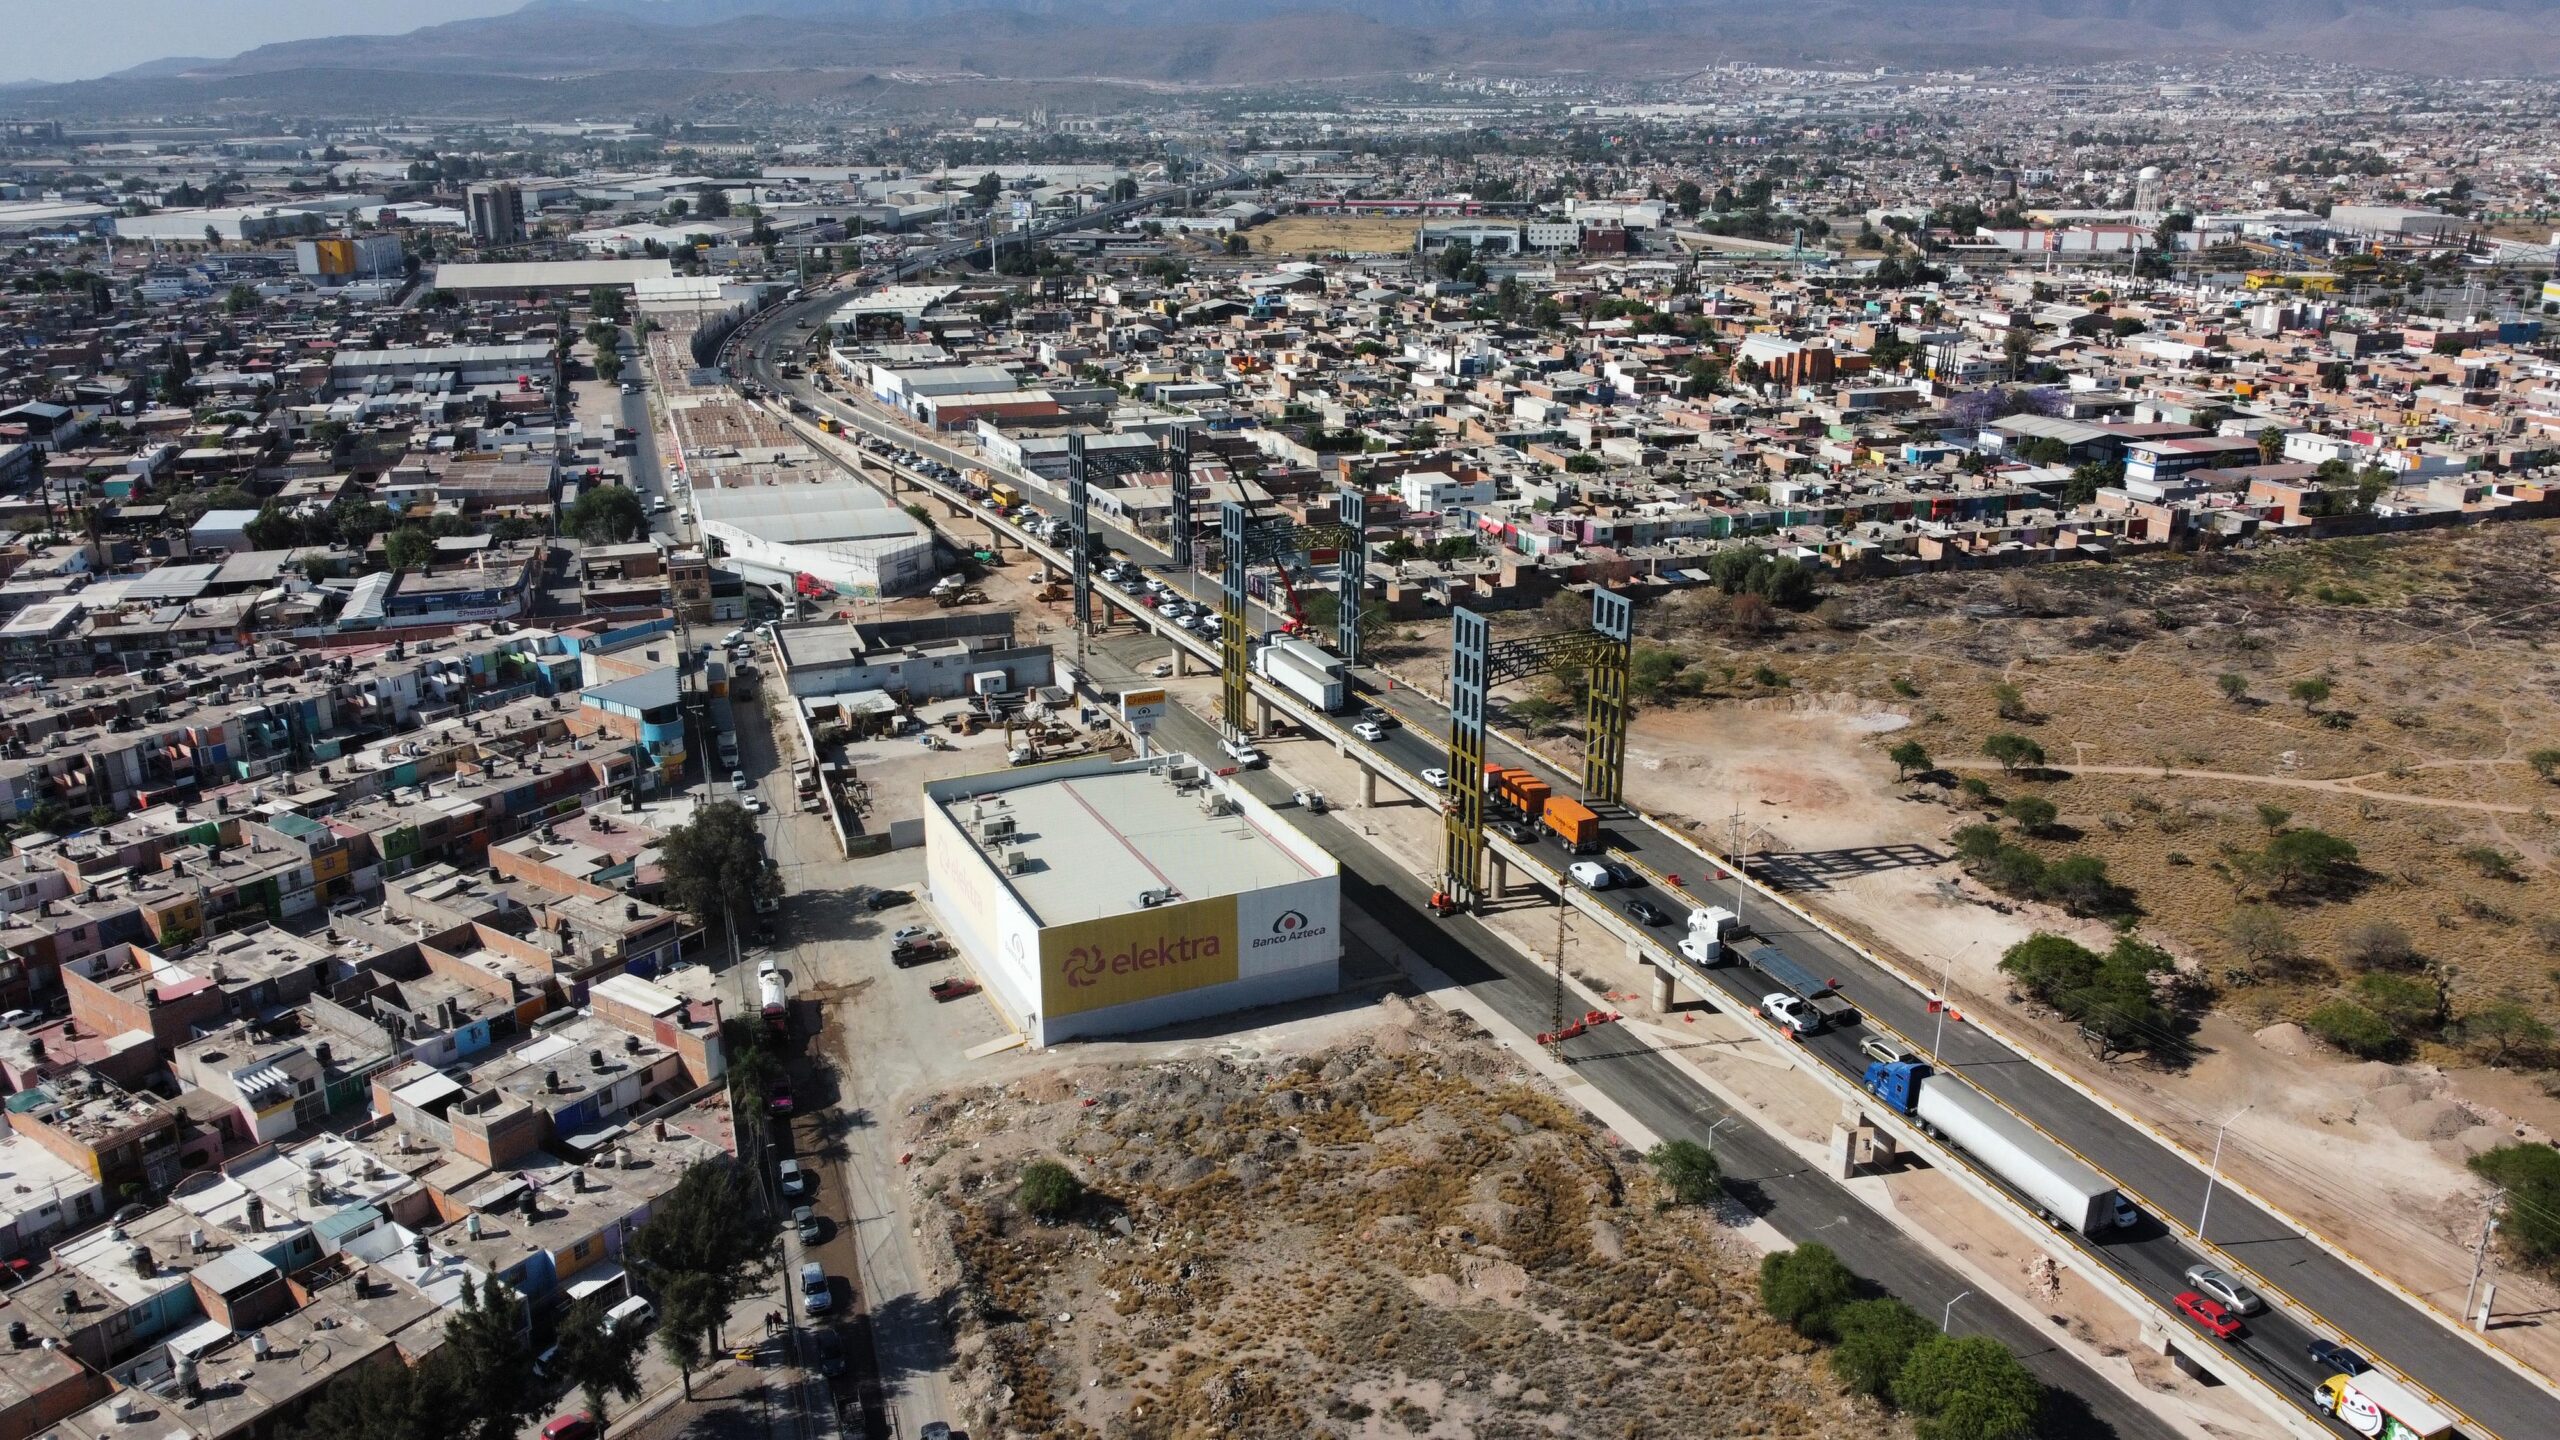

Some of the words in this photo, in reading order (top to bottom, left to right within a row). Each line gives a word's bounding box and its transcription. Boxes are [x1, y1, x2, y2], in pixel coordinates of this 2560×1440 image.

[1137, 693, 1164, 704] elektra
[1252, 935, 1287, 948] Banco
[1288, 926, 1326, 942] Azteca
[1111, 936, 1219, 975] elektra
